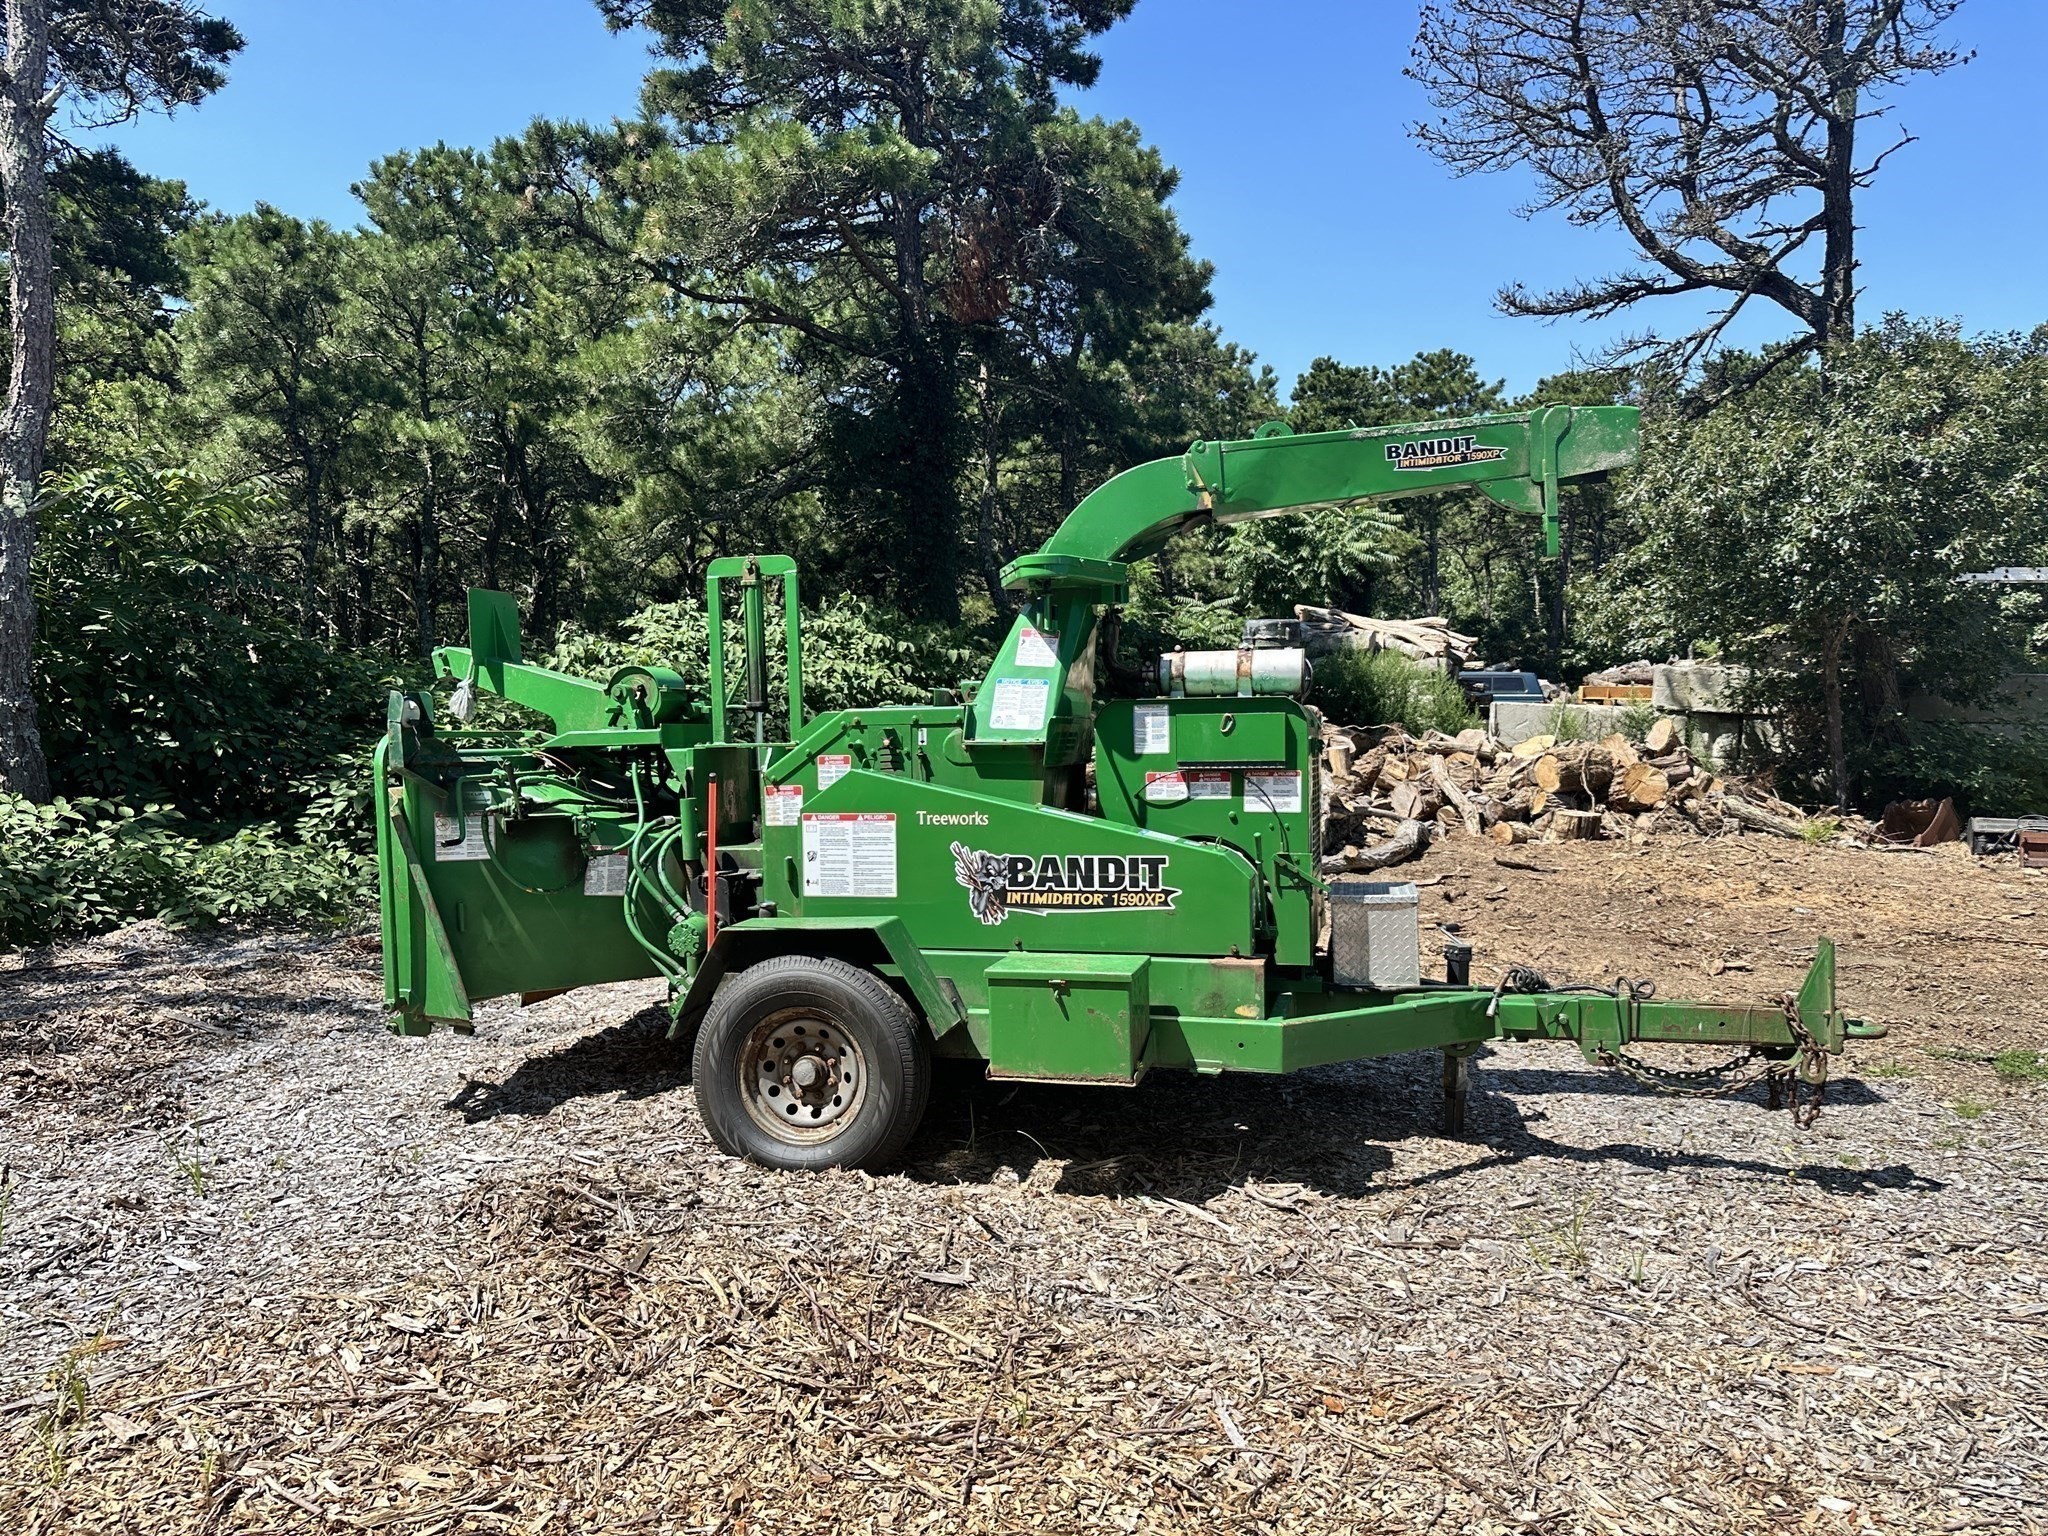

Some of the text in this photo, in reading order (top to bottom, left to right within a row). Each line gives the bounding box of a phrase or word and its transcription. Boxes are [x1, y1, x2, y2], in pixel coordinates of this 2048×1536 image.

[1386, 436, 1475, 460] BANDIT
[1400, 449, 1500, 468] INTIMIDATOR 1590XP
[916, 810, 989, 826] Treeworks
[1007, 856, 1167, 890] BANDIT
[1006, 891, 1166, 906] INTIMIDATOR 1590XP
